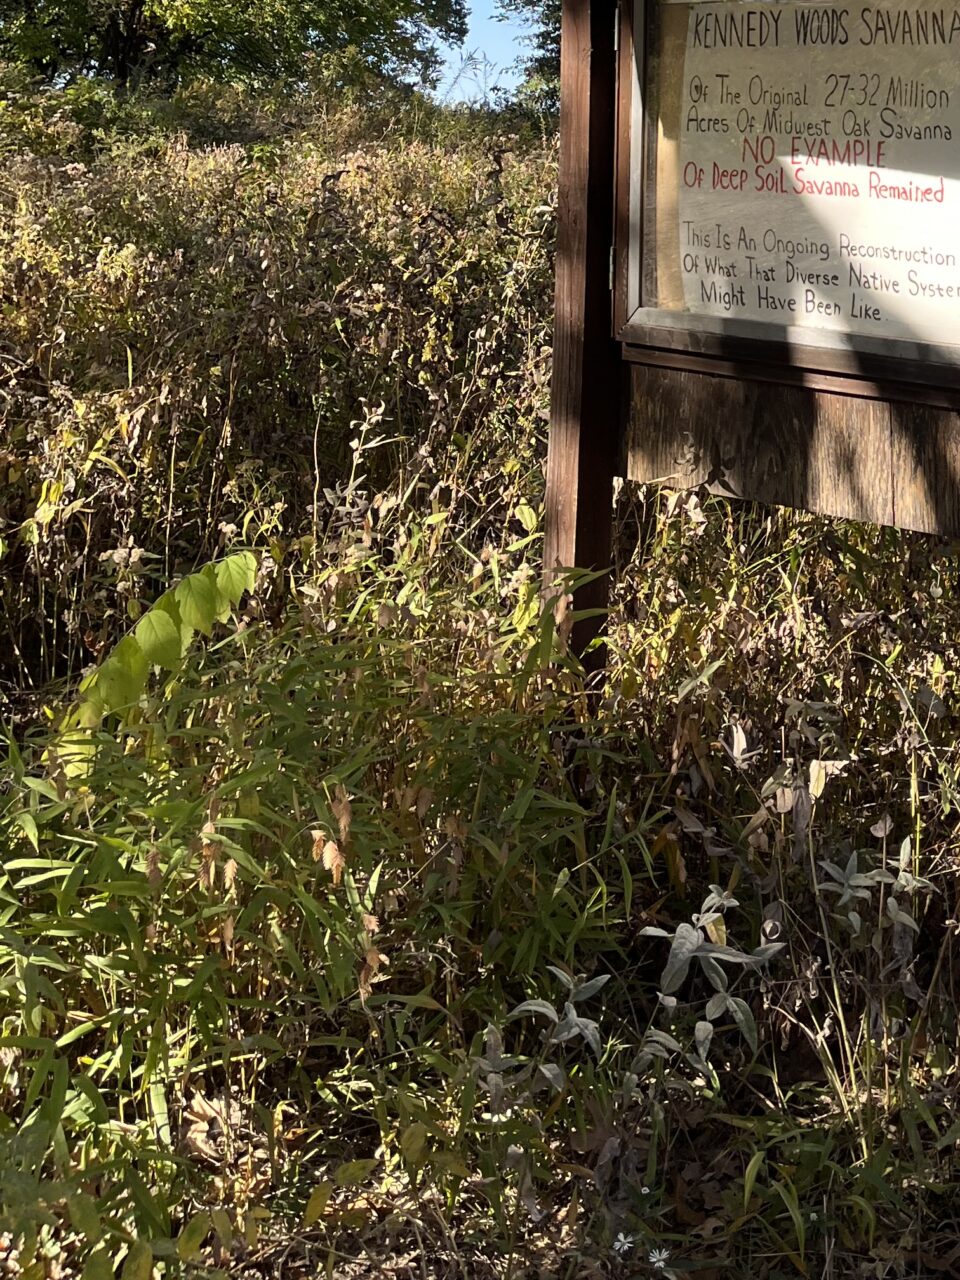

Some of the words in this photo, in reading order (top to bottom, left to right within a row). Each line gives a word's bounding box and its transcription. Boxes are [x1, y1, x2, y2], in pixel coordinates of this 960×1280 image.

[692, 8, 782, 48] KENNEDY
[795, 8, 849, 45] WOODS
[689, 75, 708, 103] Of
[715, 73, 741, 105] The
[749, 74, 809, 111] Original
[824, 73, 881, 108] 27-32
[886, 76, 950, 109] Million
[686, 106, 729, 134] Acres
[736, 108, 755, 134] Of
[762, 108, 831, 137] Midwest
[841, 110, 870, 137] Oak
[879, 107, 952, 140] Savanna
[741, 135, 775, 164] NO
[791, 136, 886, 168] EXAMPLE
[683, 161, 704, 188] Of
[712, 161, 748, 191] Deep
[792, 168, 859, 197] Savanna
[869, 171, 944, 203] Remained
[683, 220, 711, 249] This
[715, 223, 731, 250] Is
[738, 225, 756, 251] An
[763, 229, 830, 261] Ongoing
[839, 233, 956, 267] Reconstruction
[683, 253, 699, 273] Of
[704, 256, 737, 278] What
[745, 256, 775, 282] That
[786, 261, 839, 286] Diverse
[849, 262, 900, 293] Native
[700, 280, 746, 310] Might
[758, 285, 796, 312] Have
[805, 289, 841, 316] Been
